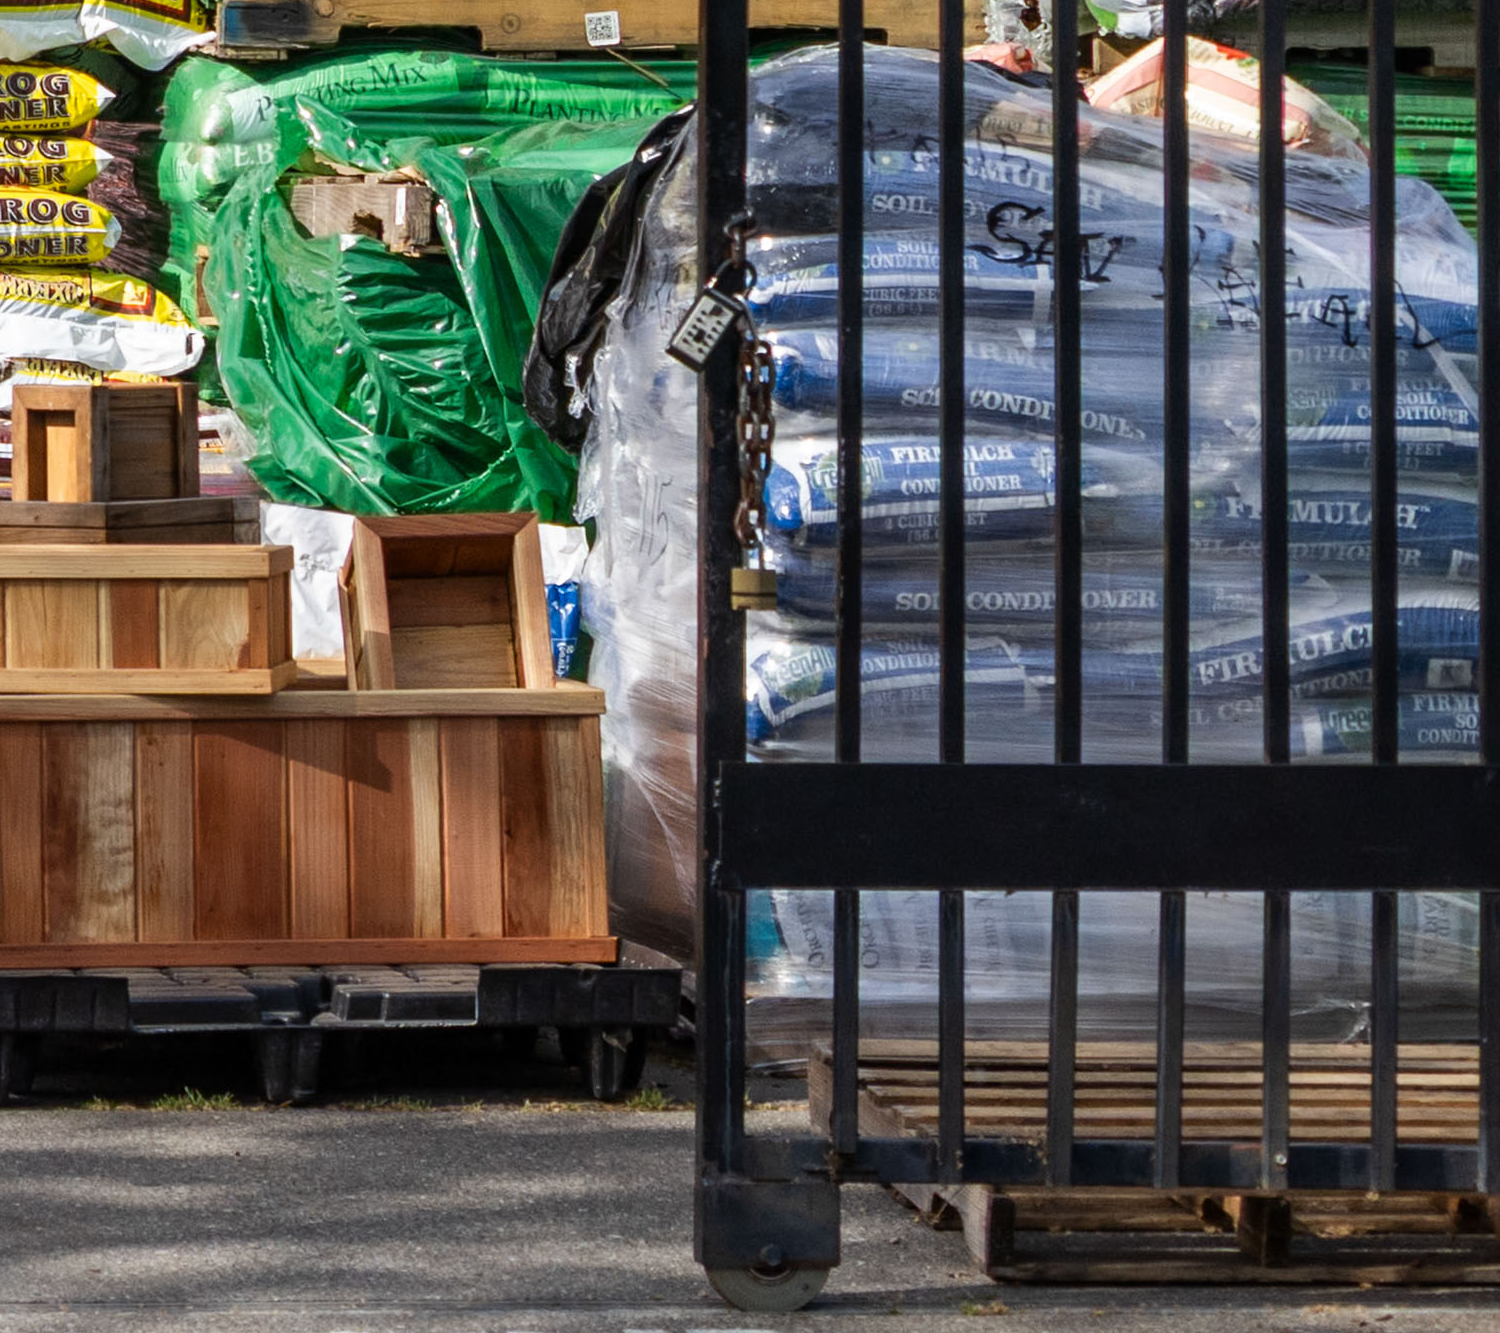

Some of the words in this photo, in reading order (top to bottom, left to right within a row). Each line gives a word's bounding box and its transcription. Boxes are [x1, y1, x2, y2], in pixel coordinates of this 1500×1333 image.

[368, 61, 428, 93] MIX
[871, 193, 934, 214] SOIL
[896, 240, 938, 254] SOIL
[1224, 495, 1418, 530] FIMULH
[965, 590, 1158, 612] CONDIONER
